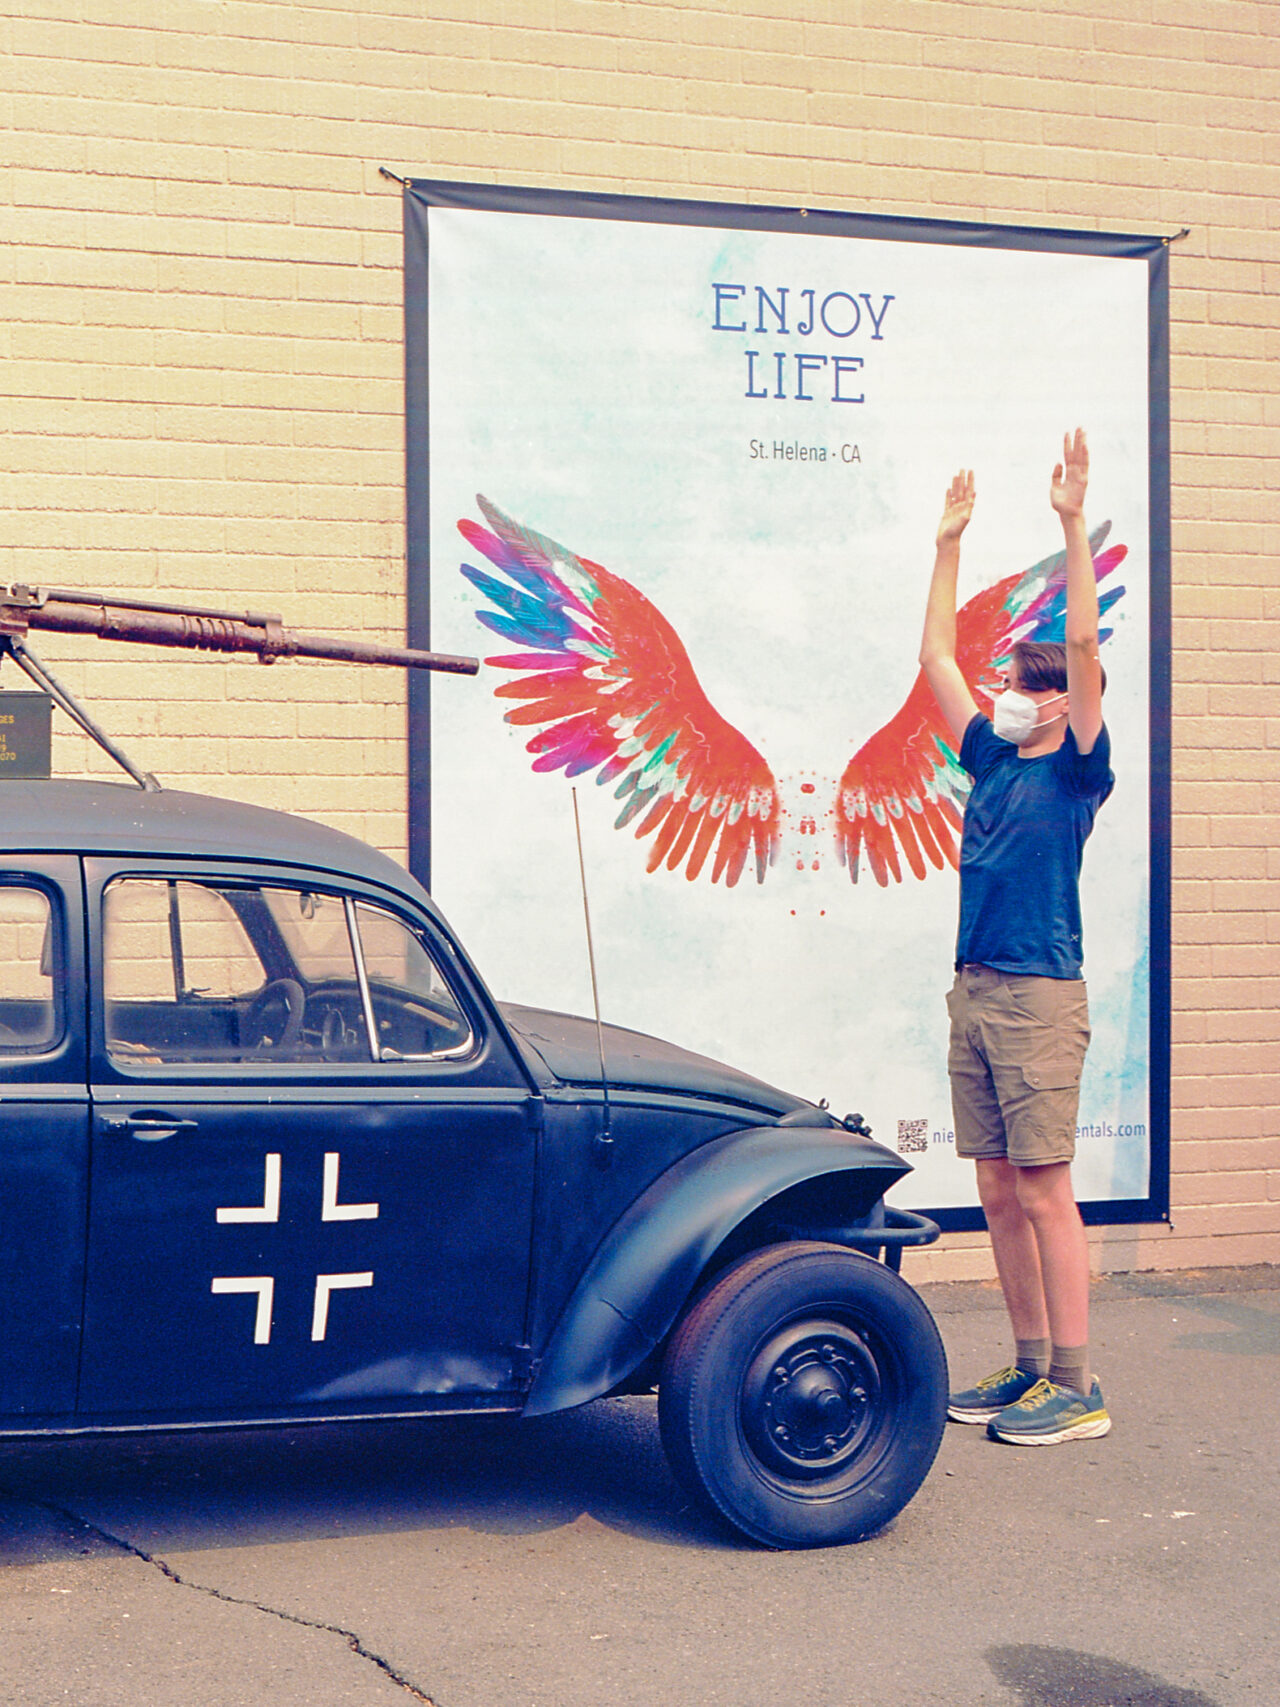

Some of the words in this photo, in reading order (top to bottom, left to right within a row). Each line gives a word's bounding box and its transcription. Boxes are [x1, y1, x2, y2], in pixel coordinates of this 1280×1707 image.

[711, 283, 896, 340] ENJOY
[744, 350, 865, 403] LIFE
[749, 439, 768, 459] St.
[772, 440, 827, 462] Helena
[841, 443, 861, 463] CA
[933, 1128, 954, 1143] nie
[1075, 1121, 1146, 1138] entals.com
